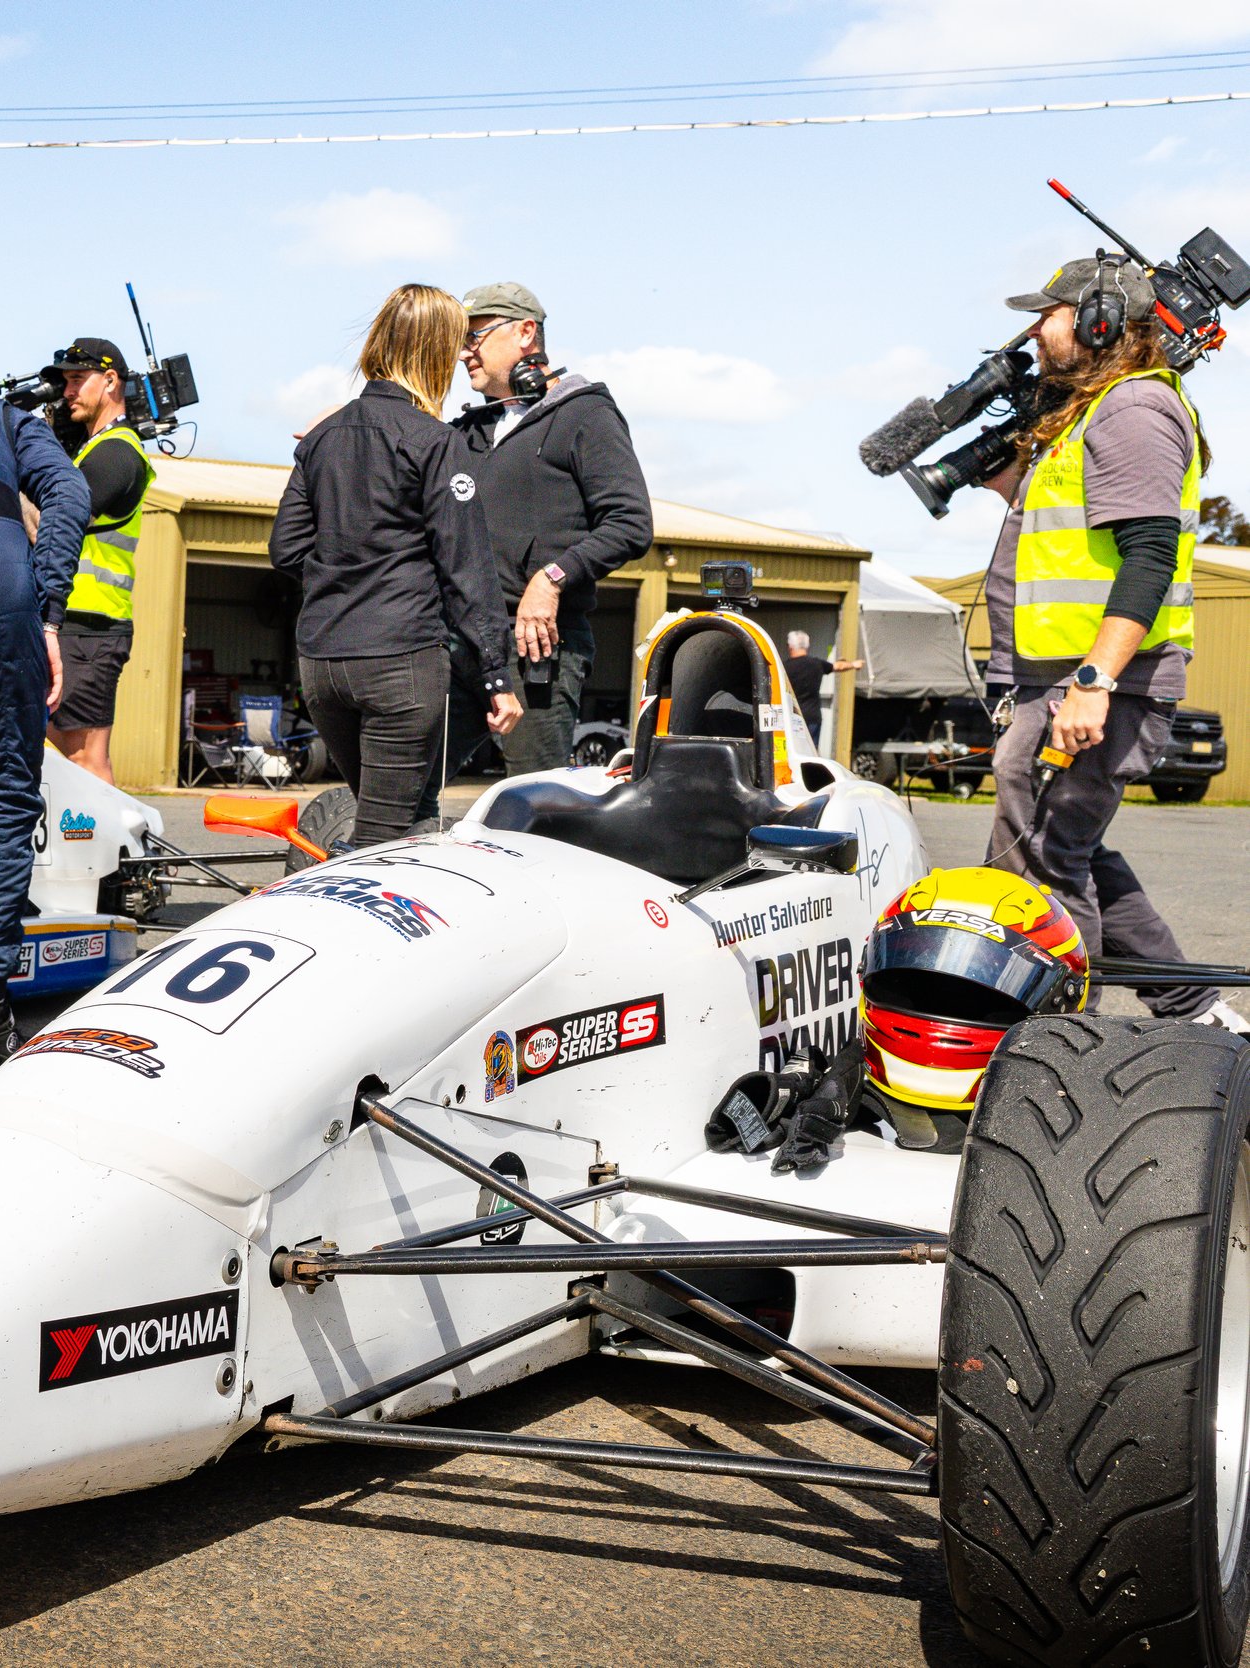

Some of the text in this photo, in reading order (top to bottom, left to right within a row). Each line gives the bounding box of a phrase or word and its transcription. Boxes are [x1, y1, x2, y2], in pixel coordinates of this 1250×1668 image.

[711, 896, 833, 948] Hunter Salvatore
[910, 909, 1006, 941] VERSA
[62, 948, 89, 960] SERIES
[64, 937, 90, 951] SUPER
[103, 938, 276, 1004] 16
[755, 937, 854, 1029] DRIVER
[561, 1010, 618, 1044] SUPER
[758, 1007, 857, 1074] DYNAM
[534, 1052, 547, 1065] Oils
[535, 1037, 557, 1052] Hi-Tec
[558, 1030, 618, 1065] SERIES
[96, 1305, 230, 1365] YOKOHAMA
